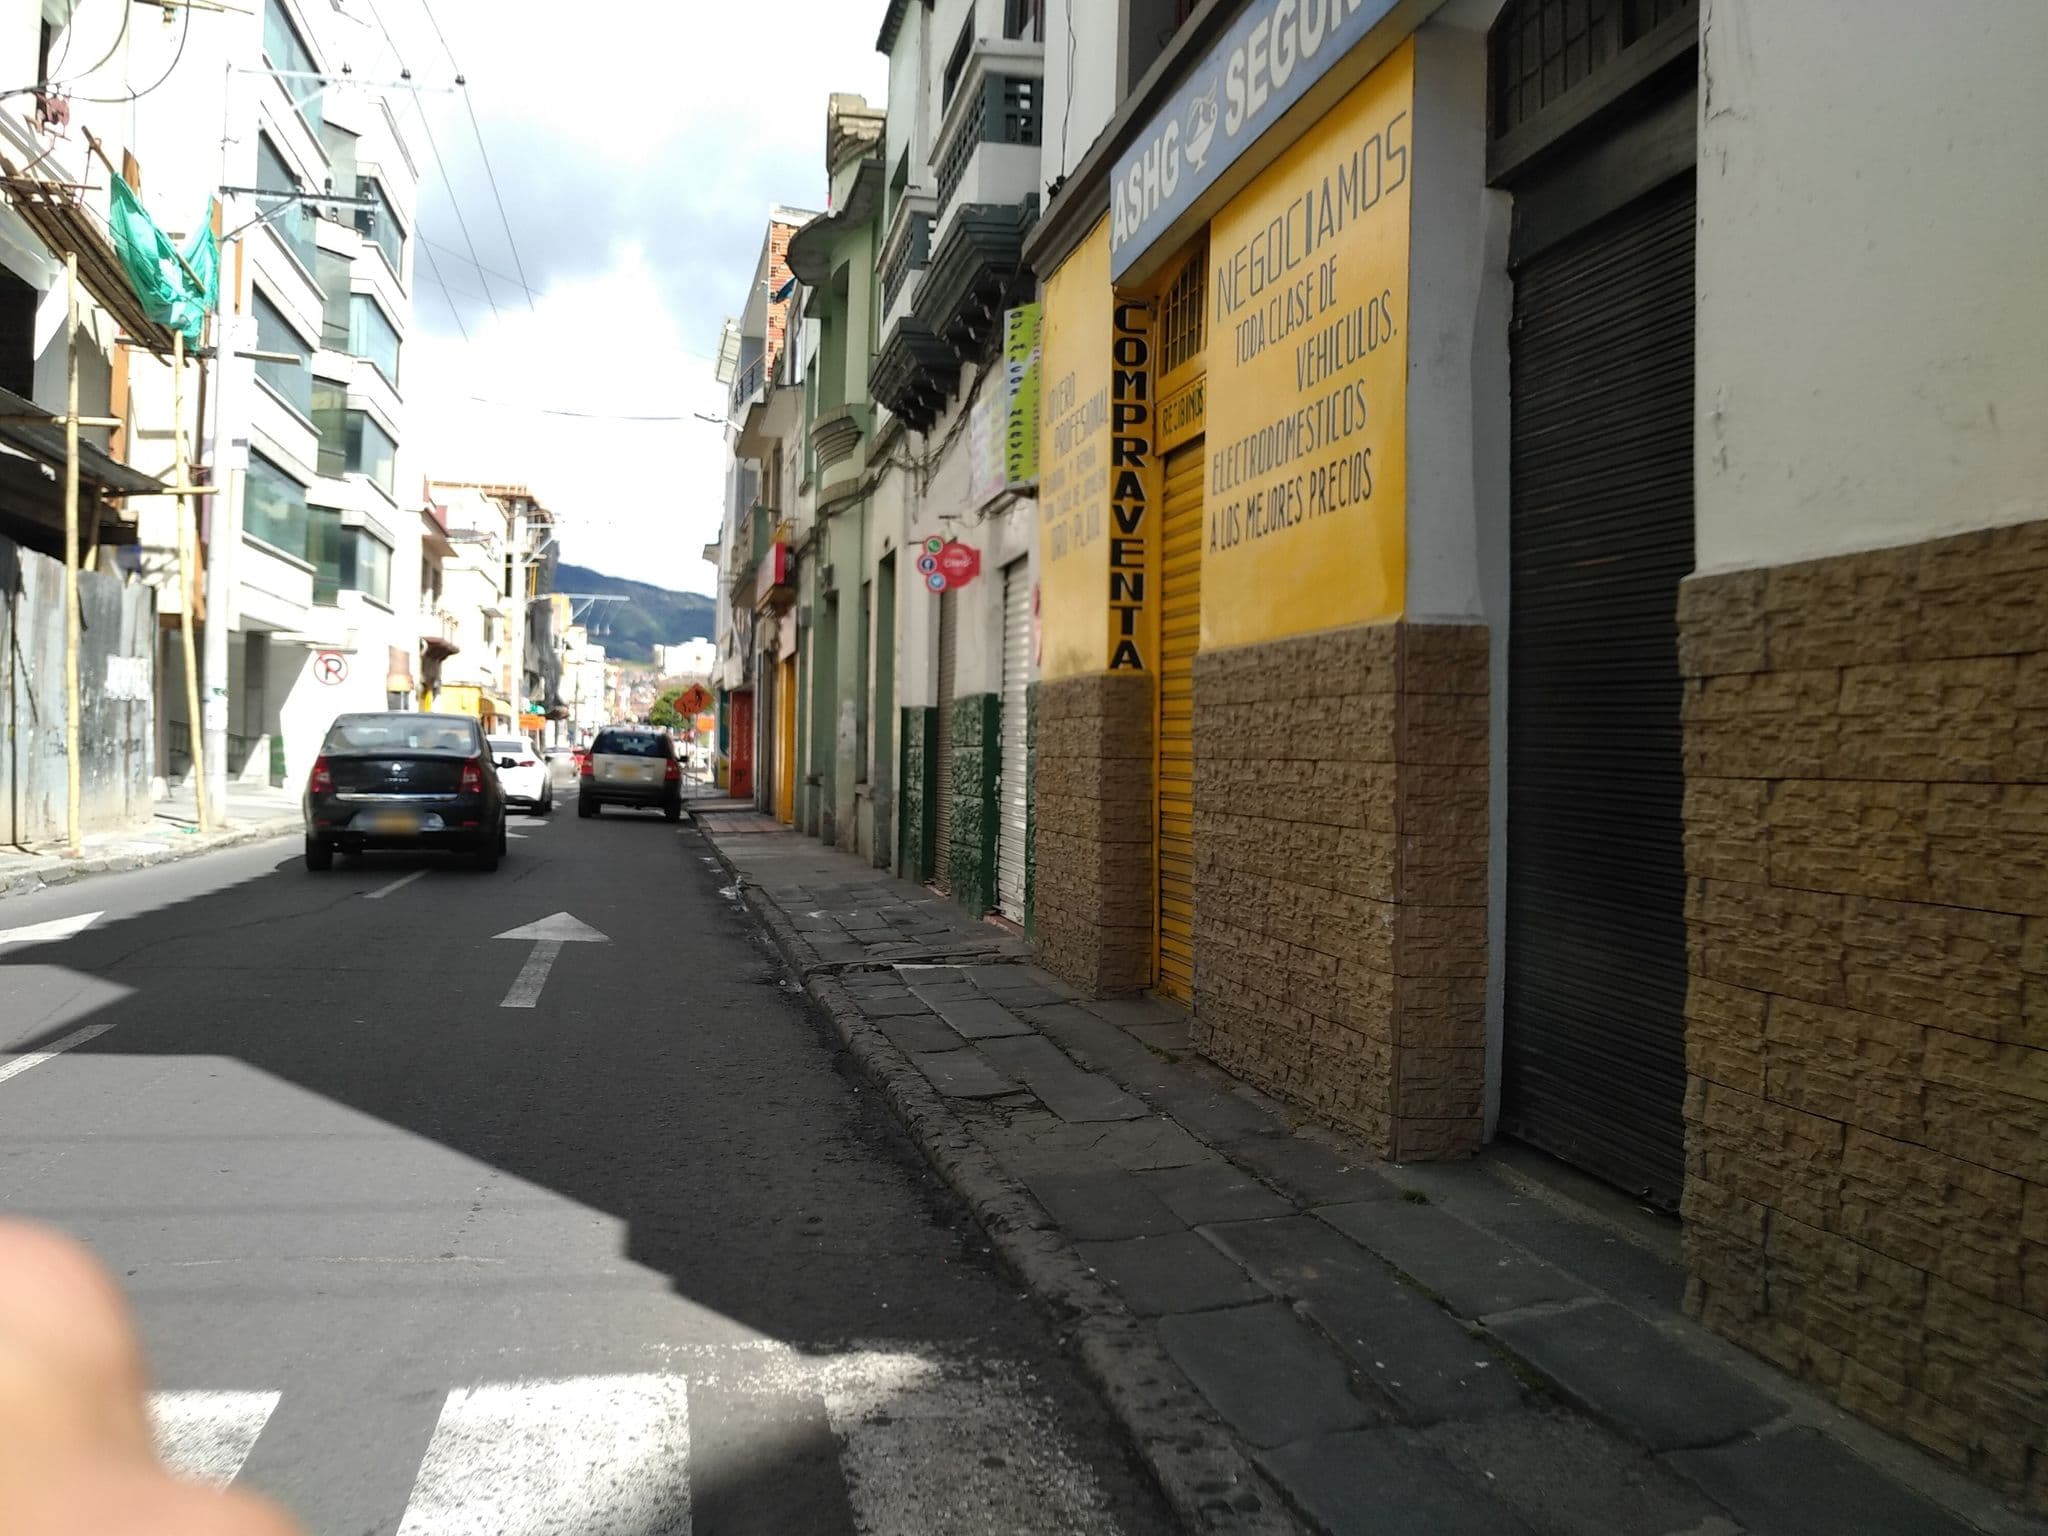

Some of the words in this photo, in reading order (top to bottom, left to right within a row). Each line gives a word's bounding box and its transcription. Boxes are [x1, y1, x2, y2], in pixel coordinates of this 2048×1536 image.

[1112, 120, 1180, 255] ASHG
[1216, 110, 1407, 324] NEGOCIAMOS
[1235, 307, 1266, 368] TODA
[1269, 271, 1314, 345] CLASE
[1319, 253, 1338, 313] DE
[1108, 303, 1149, 670] COMPRAVENTA
[1210, 511, 1218, 554] A
[1221, 503, 1241, 551] LOS
[1245, 475, 1304, 542] MEJORES
[1309, 447, 1373, 520] PRECIOS
[1211, 377, 1367, 497] ELECTRODOMESTICOS
